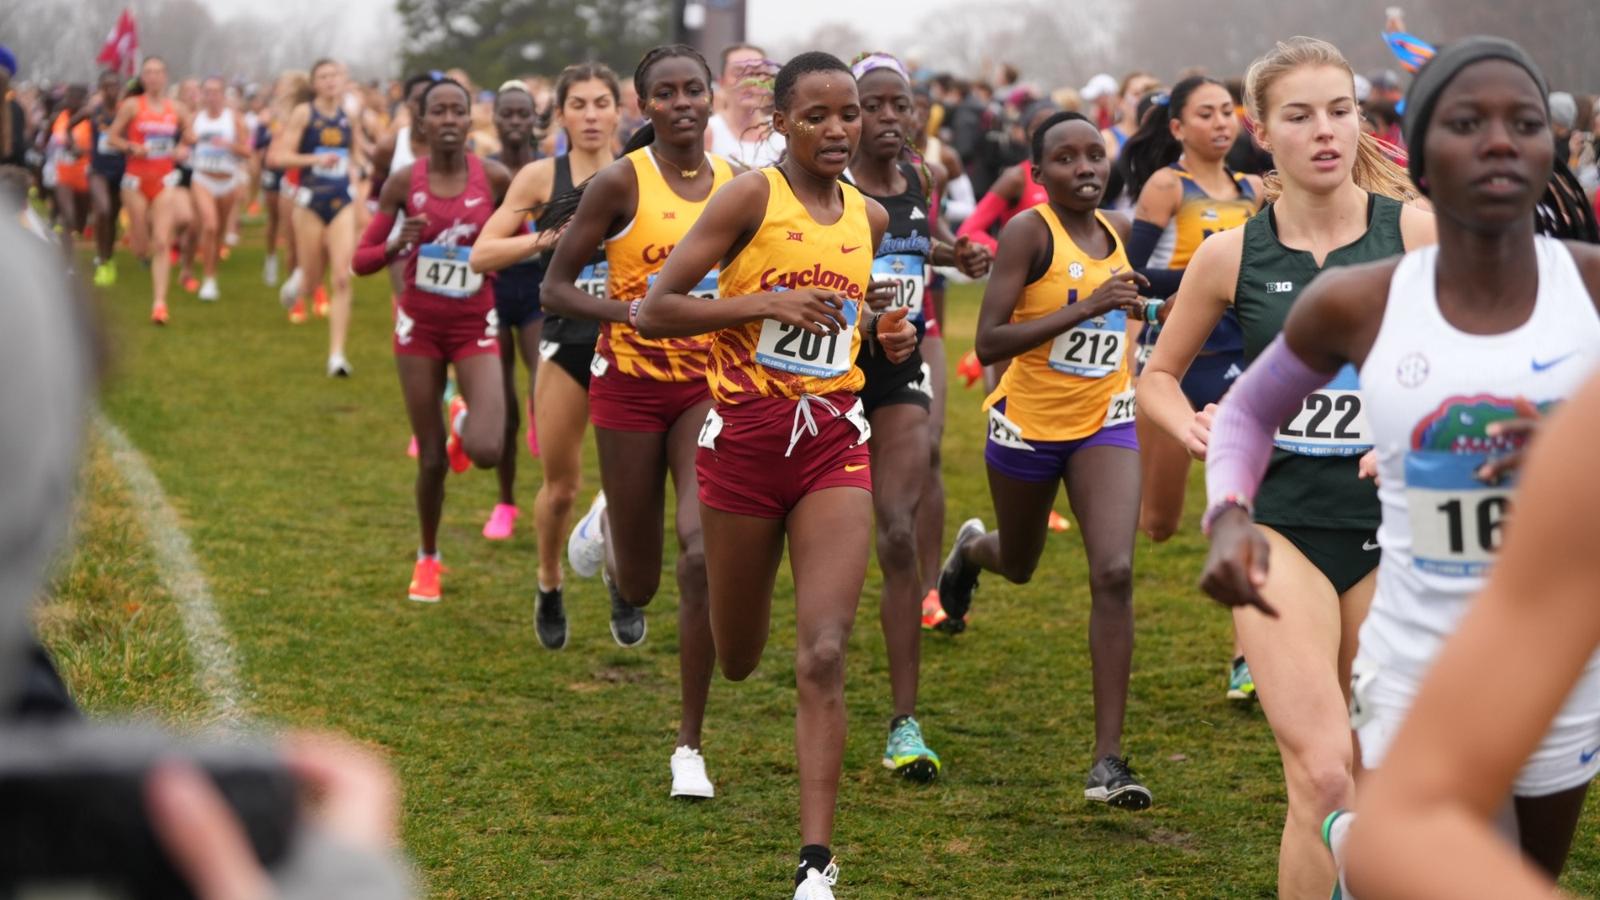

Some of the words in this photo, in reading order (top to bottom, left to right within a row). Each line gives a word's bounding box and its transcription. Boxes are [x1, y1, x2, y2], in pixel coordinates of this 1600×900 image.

[426, 263, 467, 287] 471
[888, 278, 915, 308] 02
[773, 321, 839, 365] 201
[1064, 331, 1119, 366] 212
